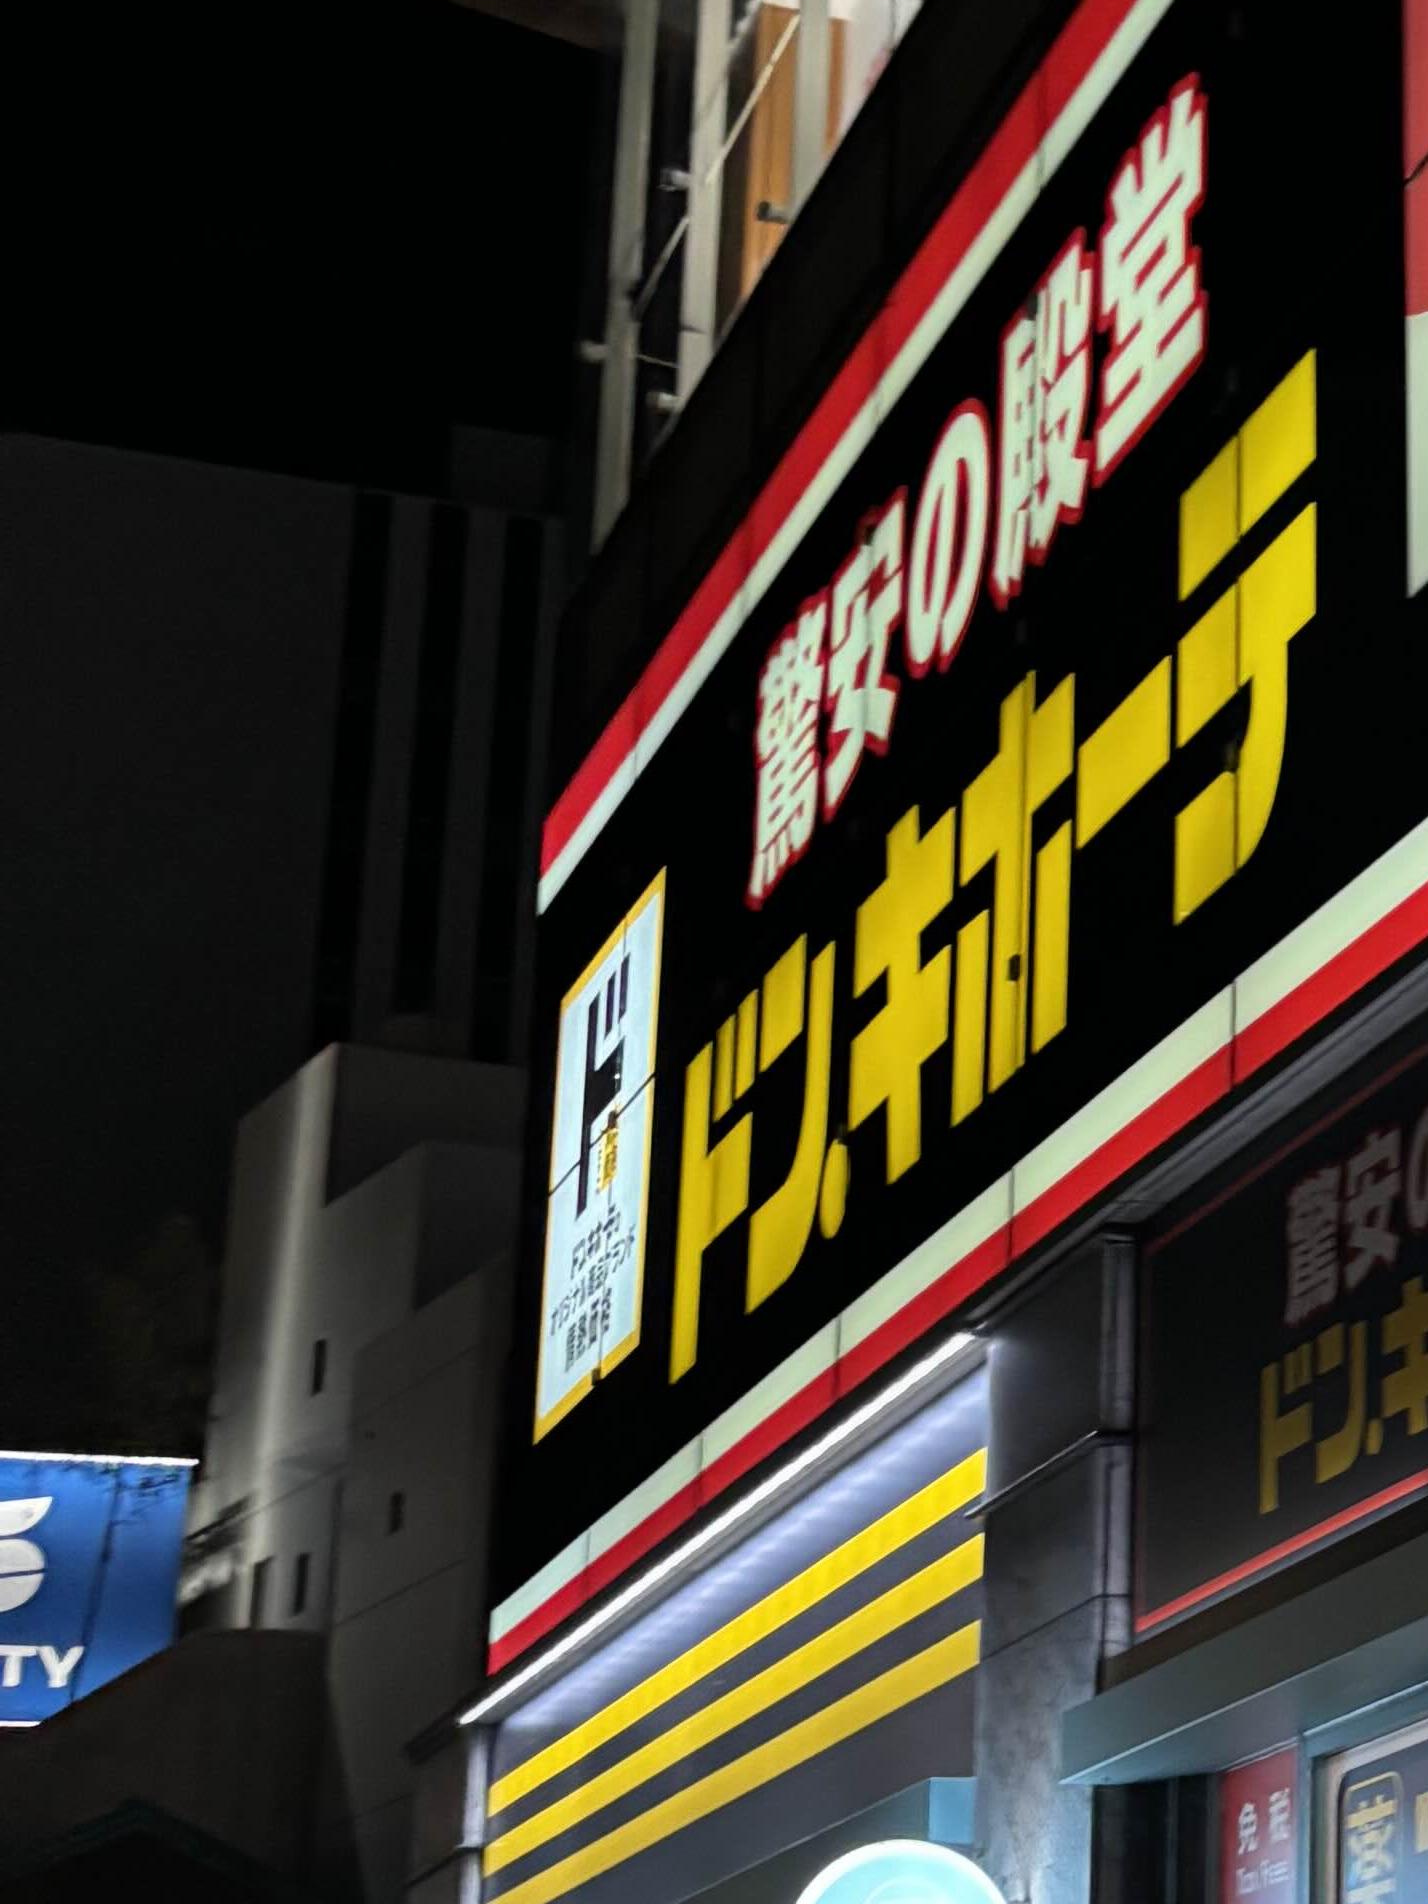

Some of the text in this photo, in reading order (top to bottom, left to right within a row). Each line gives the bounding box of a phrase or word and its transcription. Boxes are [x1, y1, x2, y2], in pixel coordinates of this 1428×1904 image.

[748, 74, 1207, 908] 驚安の殿堂
